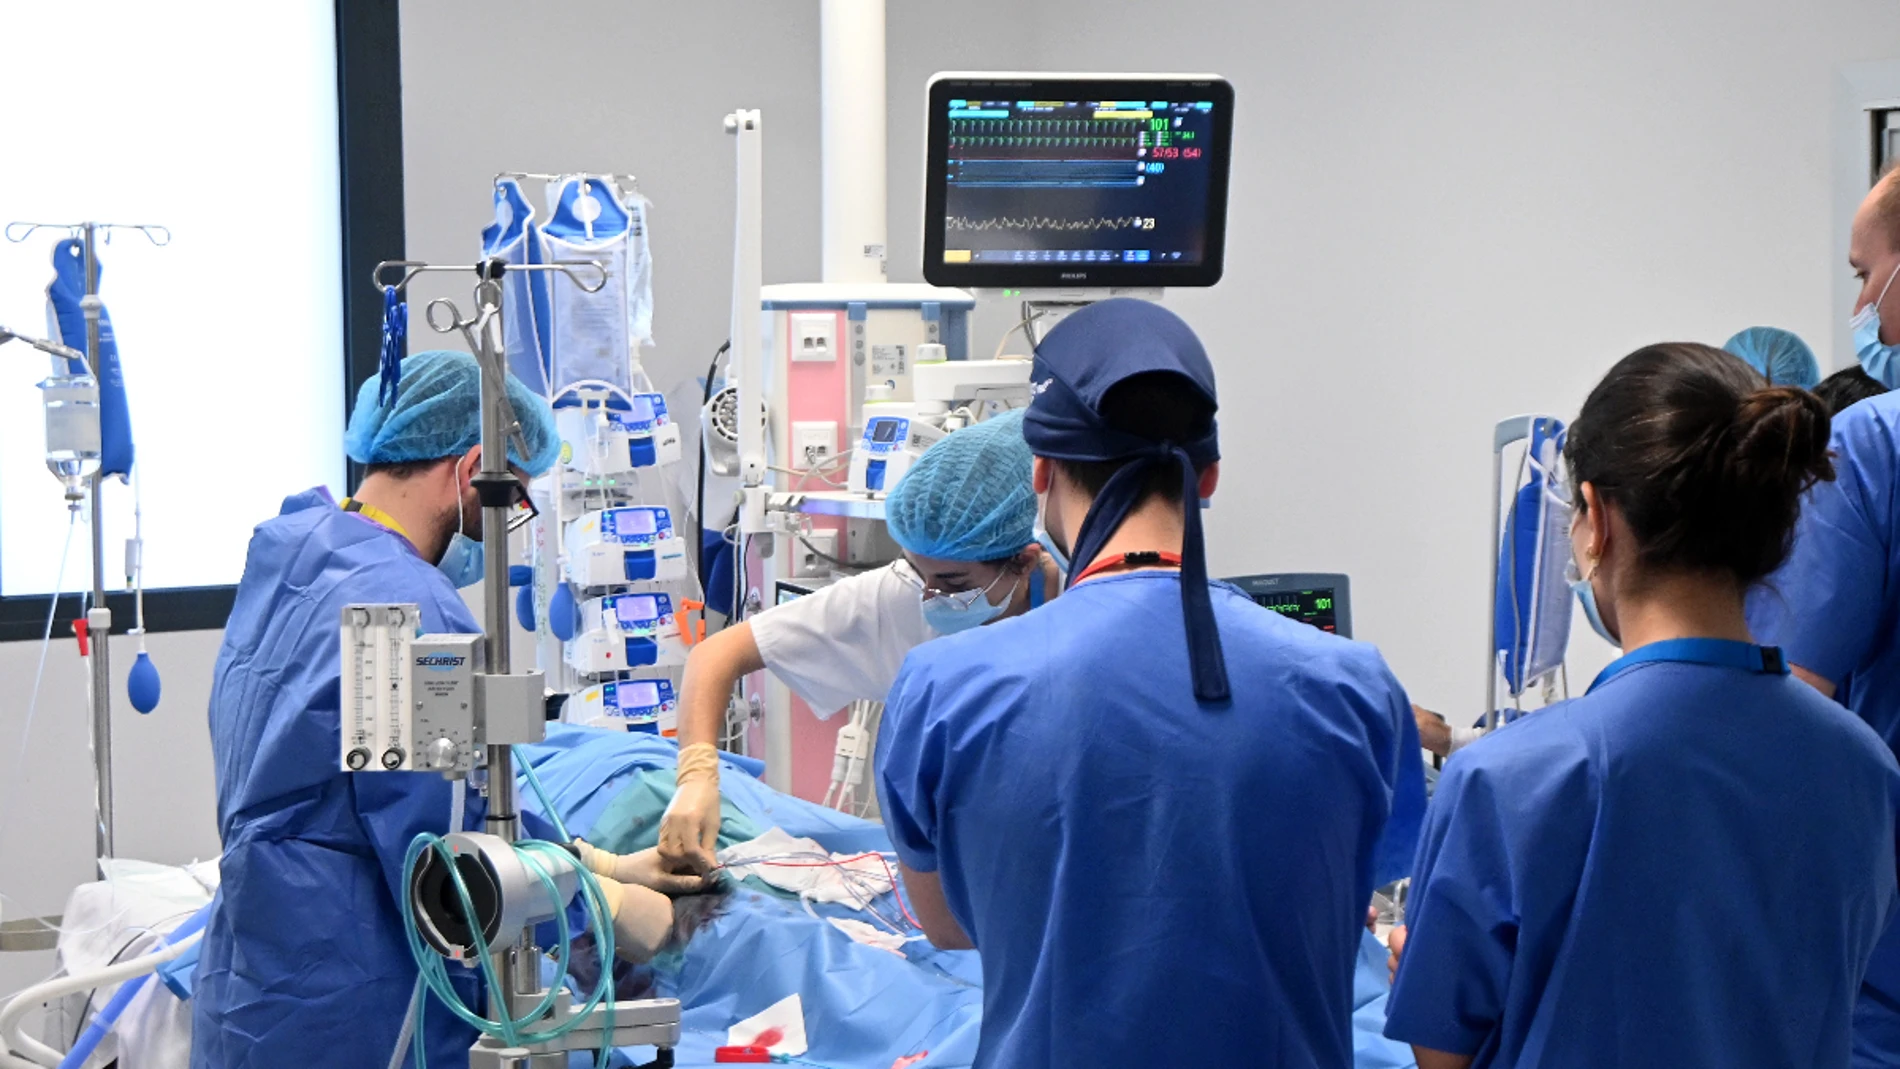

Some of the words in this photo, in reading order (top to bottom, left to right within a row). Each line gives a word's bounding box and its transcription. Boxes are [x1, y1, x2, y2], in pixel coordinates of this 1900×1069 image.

[1150, 118, 1169, 131] 101
[1152, 147, 1179, 158] 57/53
[1182, 148, 1202, 158] (54)
[1142, 218, 1155, 229] 23
[1315, 598, 1332, 609] 101
[415, 656, 466, 666] SECHRIST
